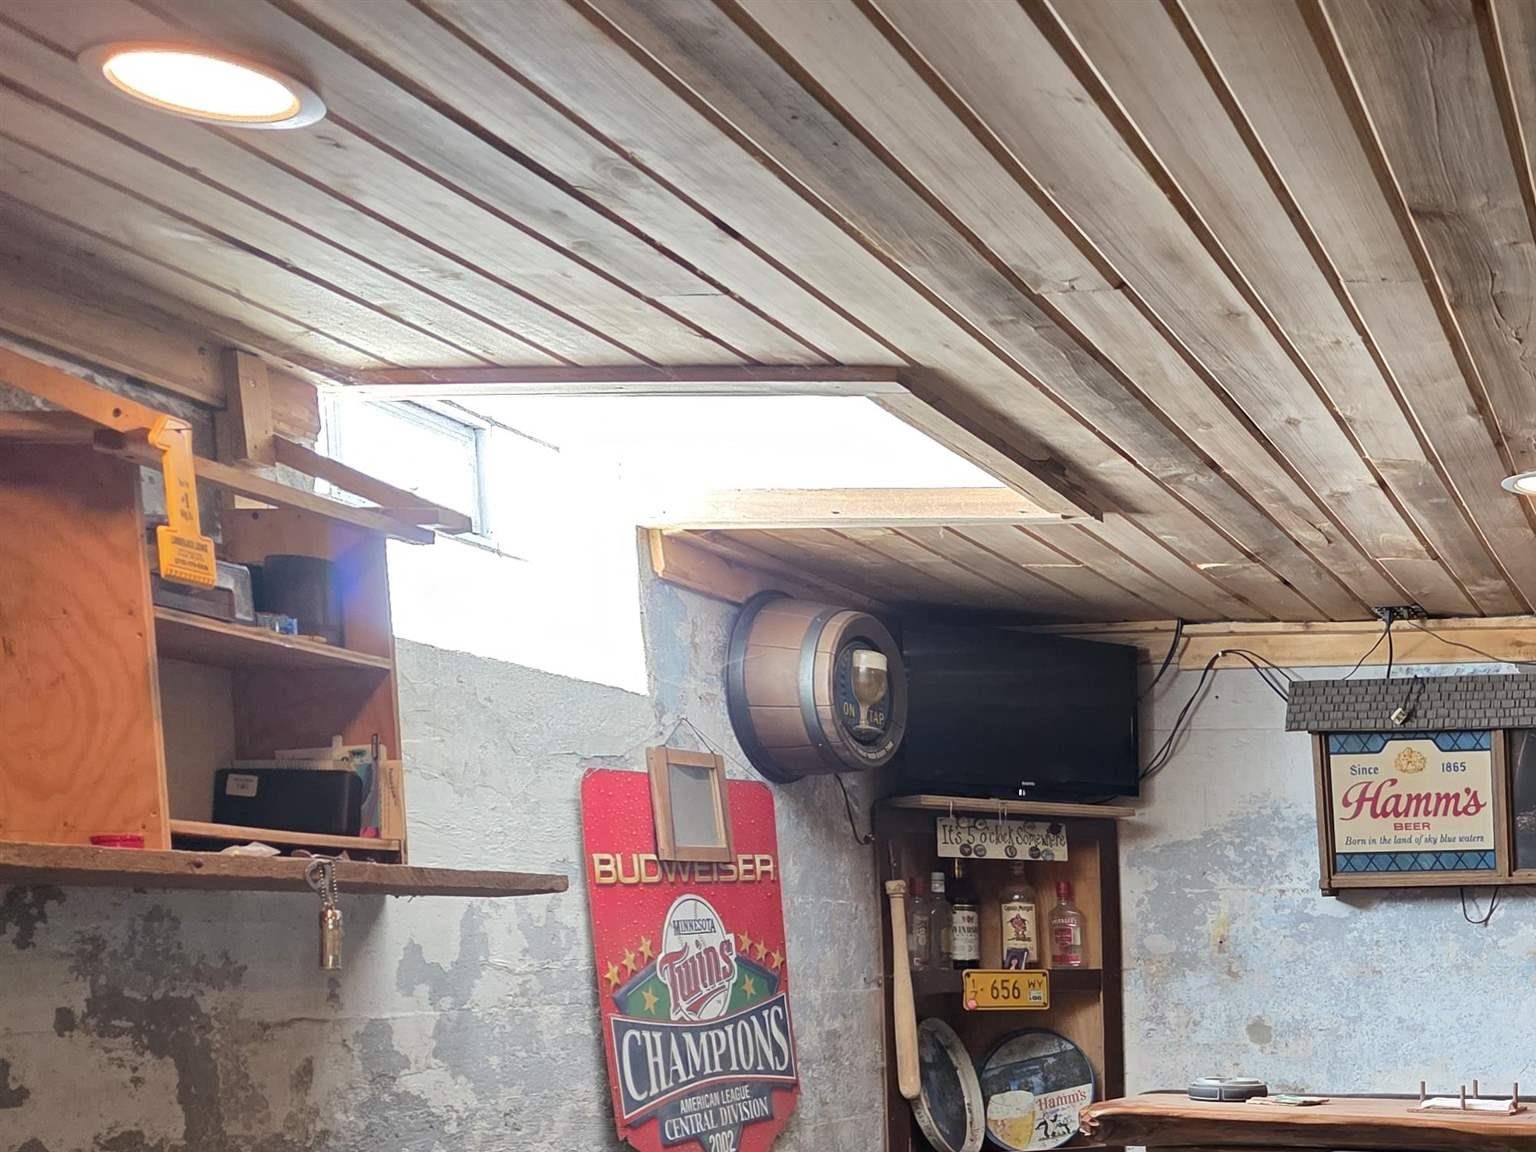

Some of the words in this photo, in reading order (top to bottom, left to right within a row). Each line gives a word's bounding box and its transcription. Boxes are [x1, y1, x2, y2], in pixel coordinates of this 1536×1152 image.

[869, 709, 885, 725] TAP
[1350, 764, 1380, 777] Since
[1441, 762, 1467, 773] 1865
[1339, 778, 1487, 821] Hamm's
[966, 825, 976, 845] 5
[1393, 822, 1431, 831] BEER
[1345, 835, 1366, 846] Born
[1368, 835, 1377, 845] in
[1379, 835, 1391, 845] the
[1393, 835, 1412, 844] land
[1414, 835, 1423, 846] of
[1424, 834, 1438, 845] sky
[1439, 834, 1457, 843] blue
[1458, 834, 1485, 843] waters
[592, 853, 775, 885] BUDWEISER
[672, 918, 717, 936] MINNESOTA
[660, 939, 735, 1016] Twins
[991, 979, 1021, 1000] 656
[1027, 979, 1043, 989] WY
[622, 1005, 789, 1101] CHAMPIONS
[680, 1092, 721, 1114] AMERICAN
[722, 1085, 750, 1105] LEAGUE
[1036, 1089, 1087, 1111] Hamm's
[664, 1109, 719, 1141] CENTRAL
[720, 1096, 769, 1126] DIVISION
